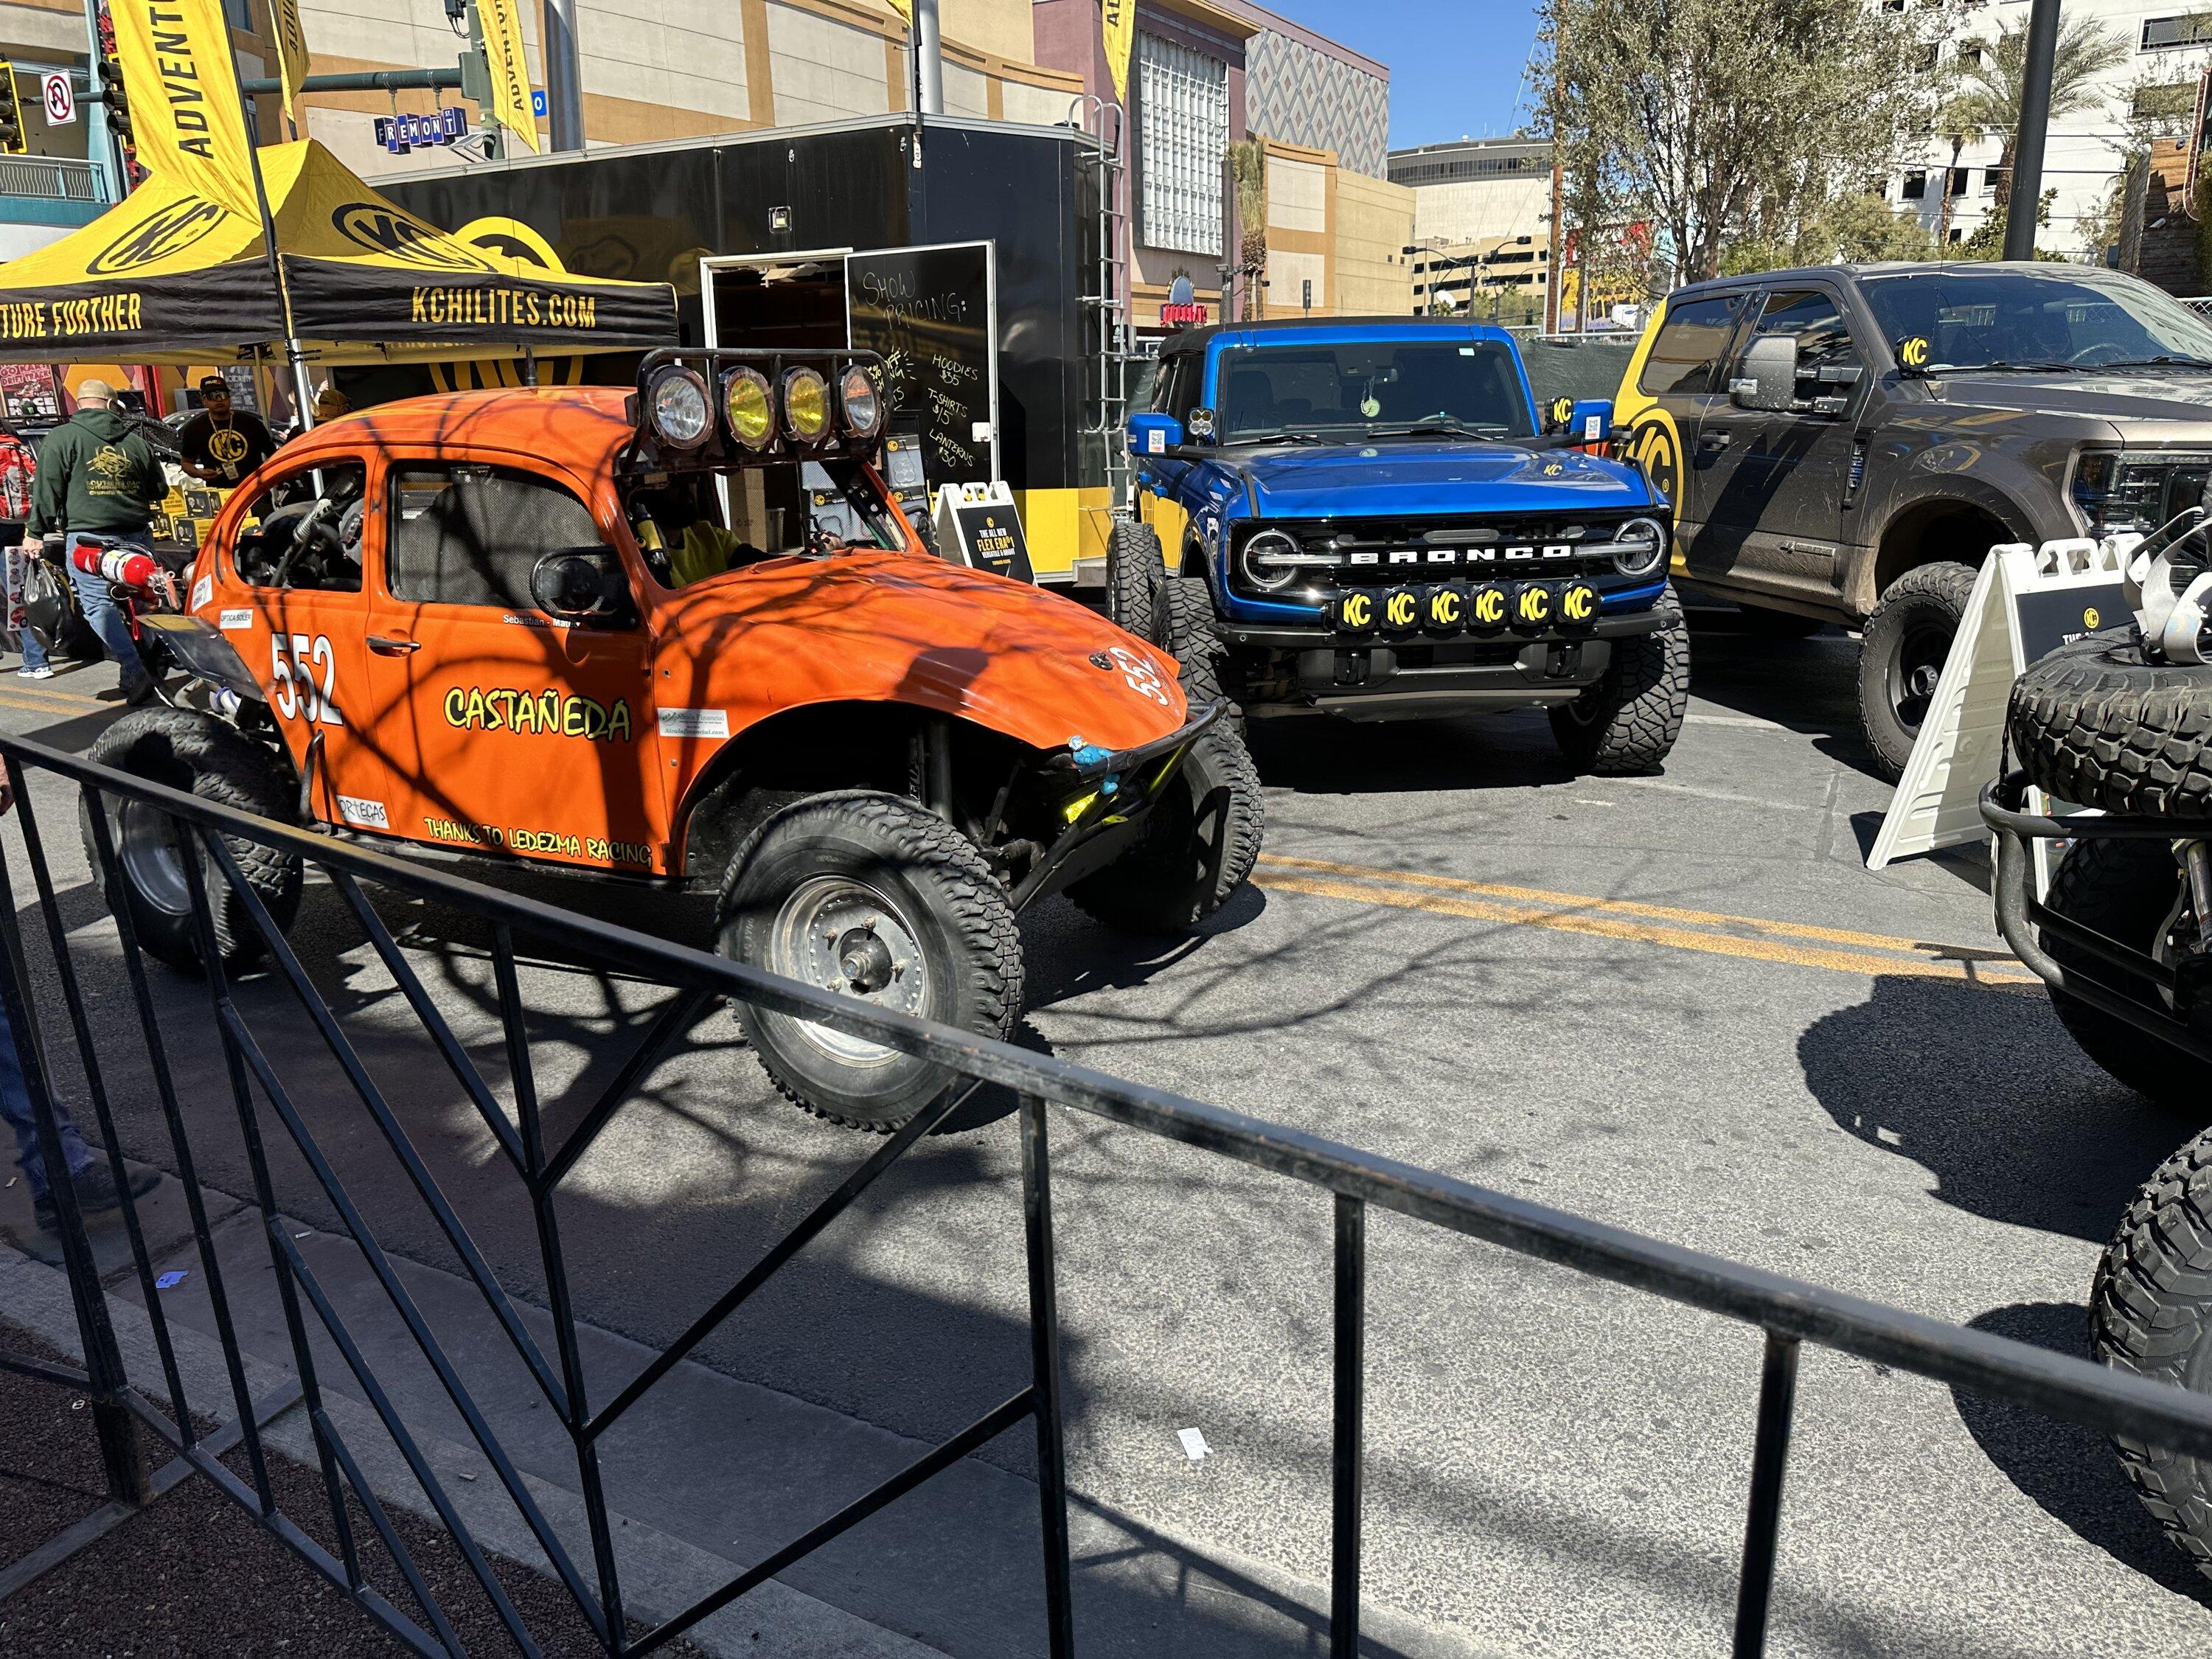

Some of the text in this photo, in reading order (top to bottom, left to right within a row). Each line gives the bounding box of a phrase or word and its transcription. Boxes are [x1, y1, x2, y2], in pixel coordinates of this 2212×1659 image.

[149, 0, 215, 159] ADVENT
[378, 117, 453, 142] FREMONT
[863, 270, 916, 306] SHOW
[52, 293, 142, 336] FURTHER
[411, 286, 597, 329] KCHILITES.COM
[883, 293, 967, 330] PRICING:
[1902, 337, 1927, 366] KC
[1, 374, 24, 386] DRIFT
[932, 354, 978, 380] HOODIES
[939, 370, 961, 386] $35
[928, 388, 967, 417] T-SHIRTS
[933, 405, 953, 425] $15
[1554, 397, 1572, 424] KC
[929, 428, 974, 467] LANTERNS
[939, 447, 957, 467] $30
[1543, 464, 1563, 476] KC
[976, 539, 995, 552] FLEX
[1350, 545, 1571, 565] BRONCO
[503, 613, 545, 626] Sebastian
[1343, 586, 1593, 627] KC KC KC KC KC KC
[271, 632, 344, 726] 552
[1107, 646, 1169, 706] 552
[444, 686, 630, 741] CASTAÑEDA
[423, 816, 653, 868] THANKS TO LEDEZMA RACING
